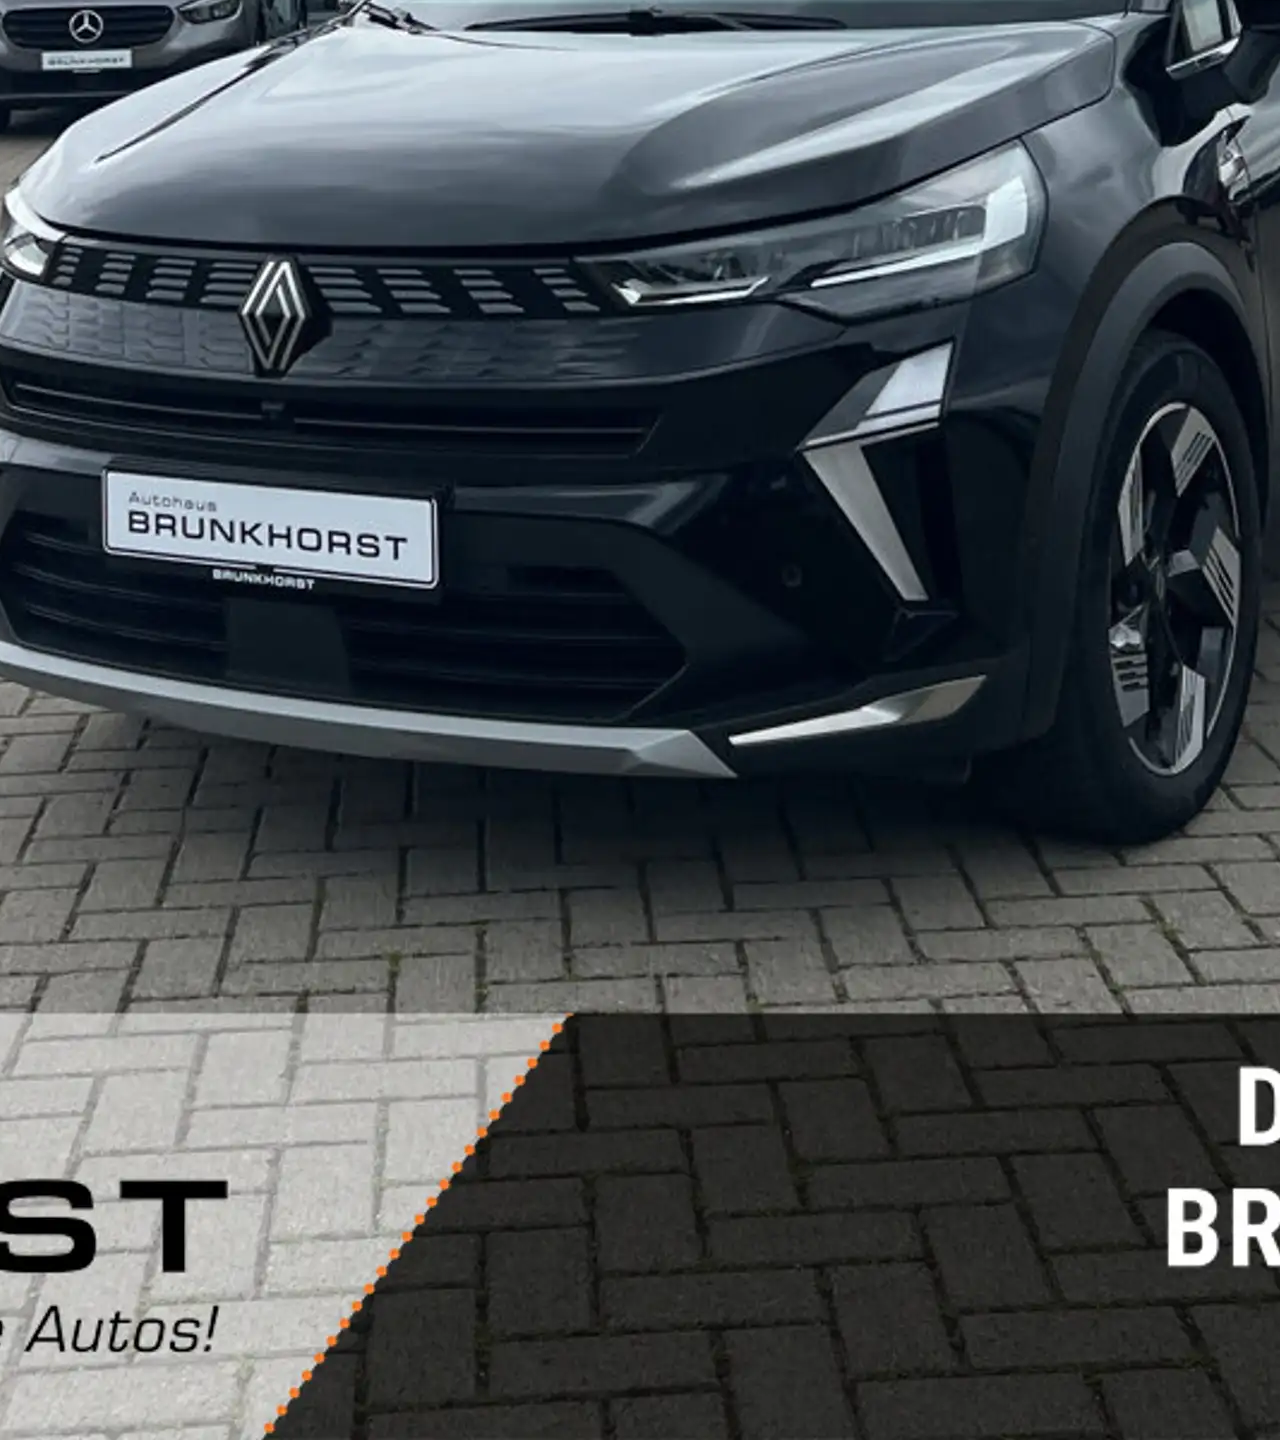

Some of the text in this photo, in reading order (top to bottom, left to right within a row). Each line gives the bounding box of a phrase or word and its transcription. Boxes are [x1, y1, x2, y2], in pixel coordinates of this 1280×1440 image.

[128, 491, 217, 512] Autohaus
[128, 509, 408, 561] BRUNKHORST
[212, 568, 316, 590] BRUNKHORST
